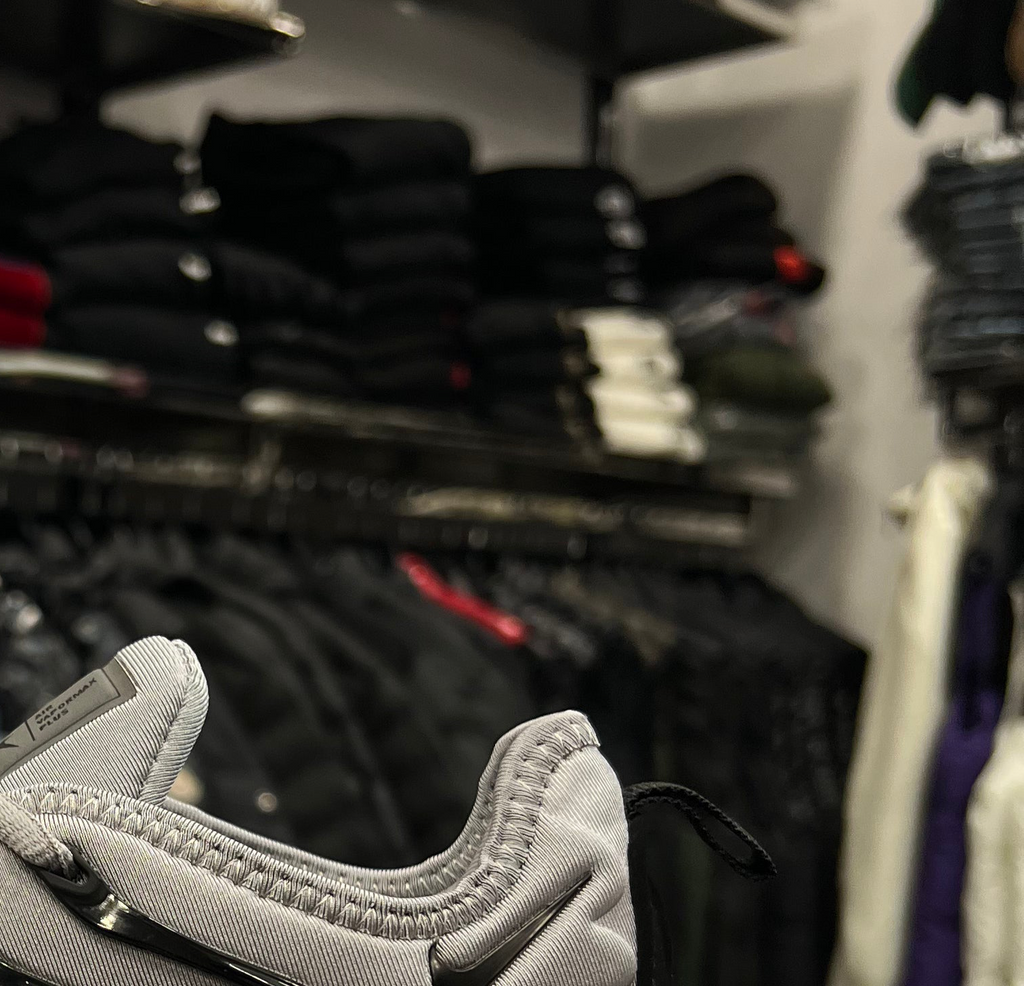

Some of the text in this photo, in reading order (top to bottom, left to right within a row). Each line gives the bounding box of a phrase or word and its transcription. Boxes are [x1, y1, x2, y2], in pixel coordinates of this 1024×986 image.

[35, 704, 53, 720] AIR
[36, 677, 97, 724] VAPORMAX
[39, 708, 69, 731] PLUS
